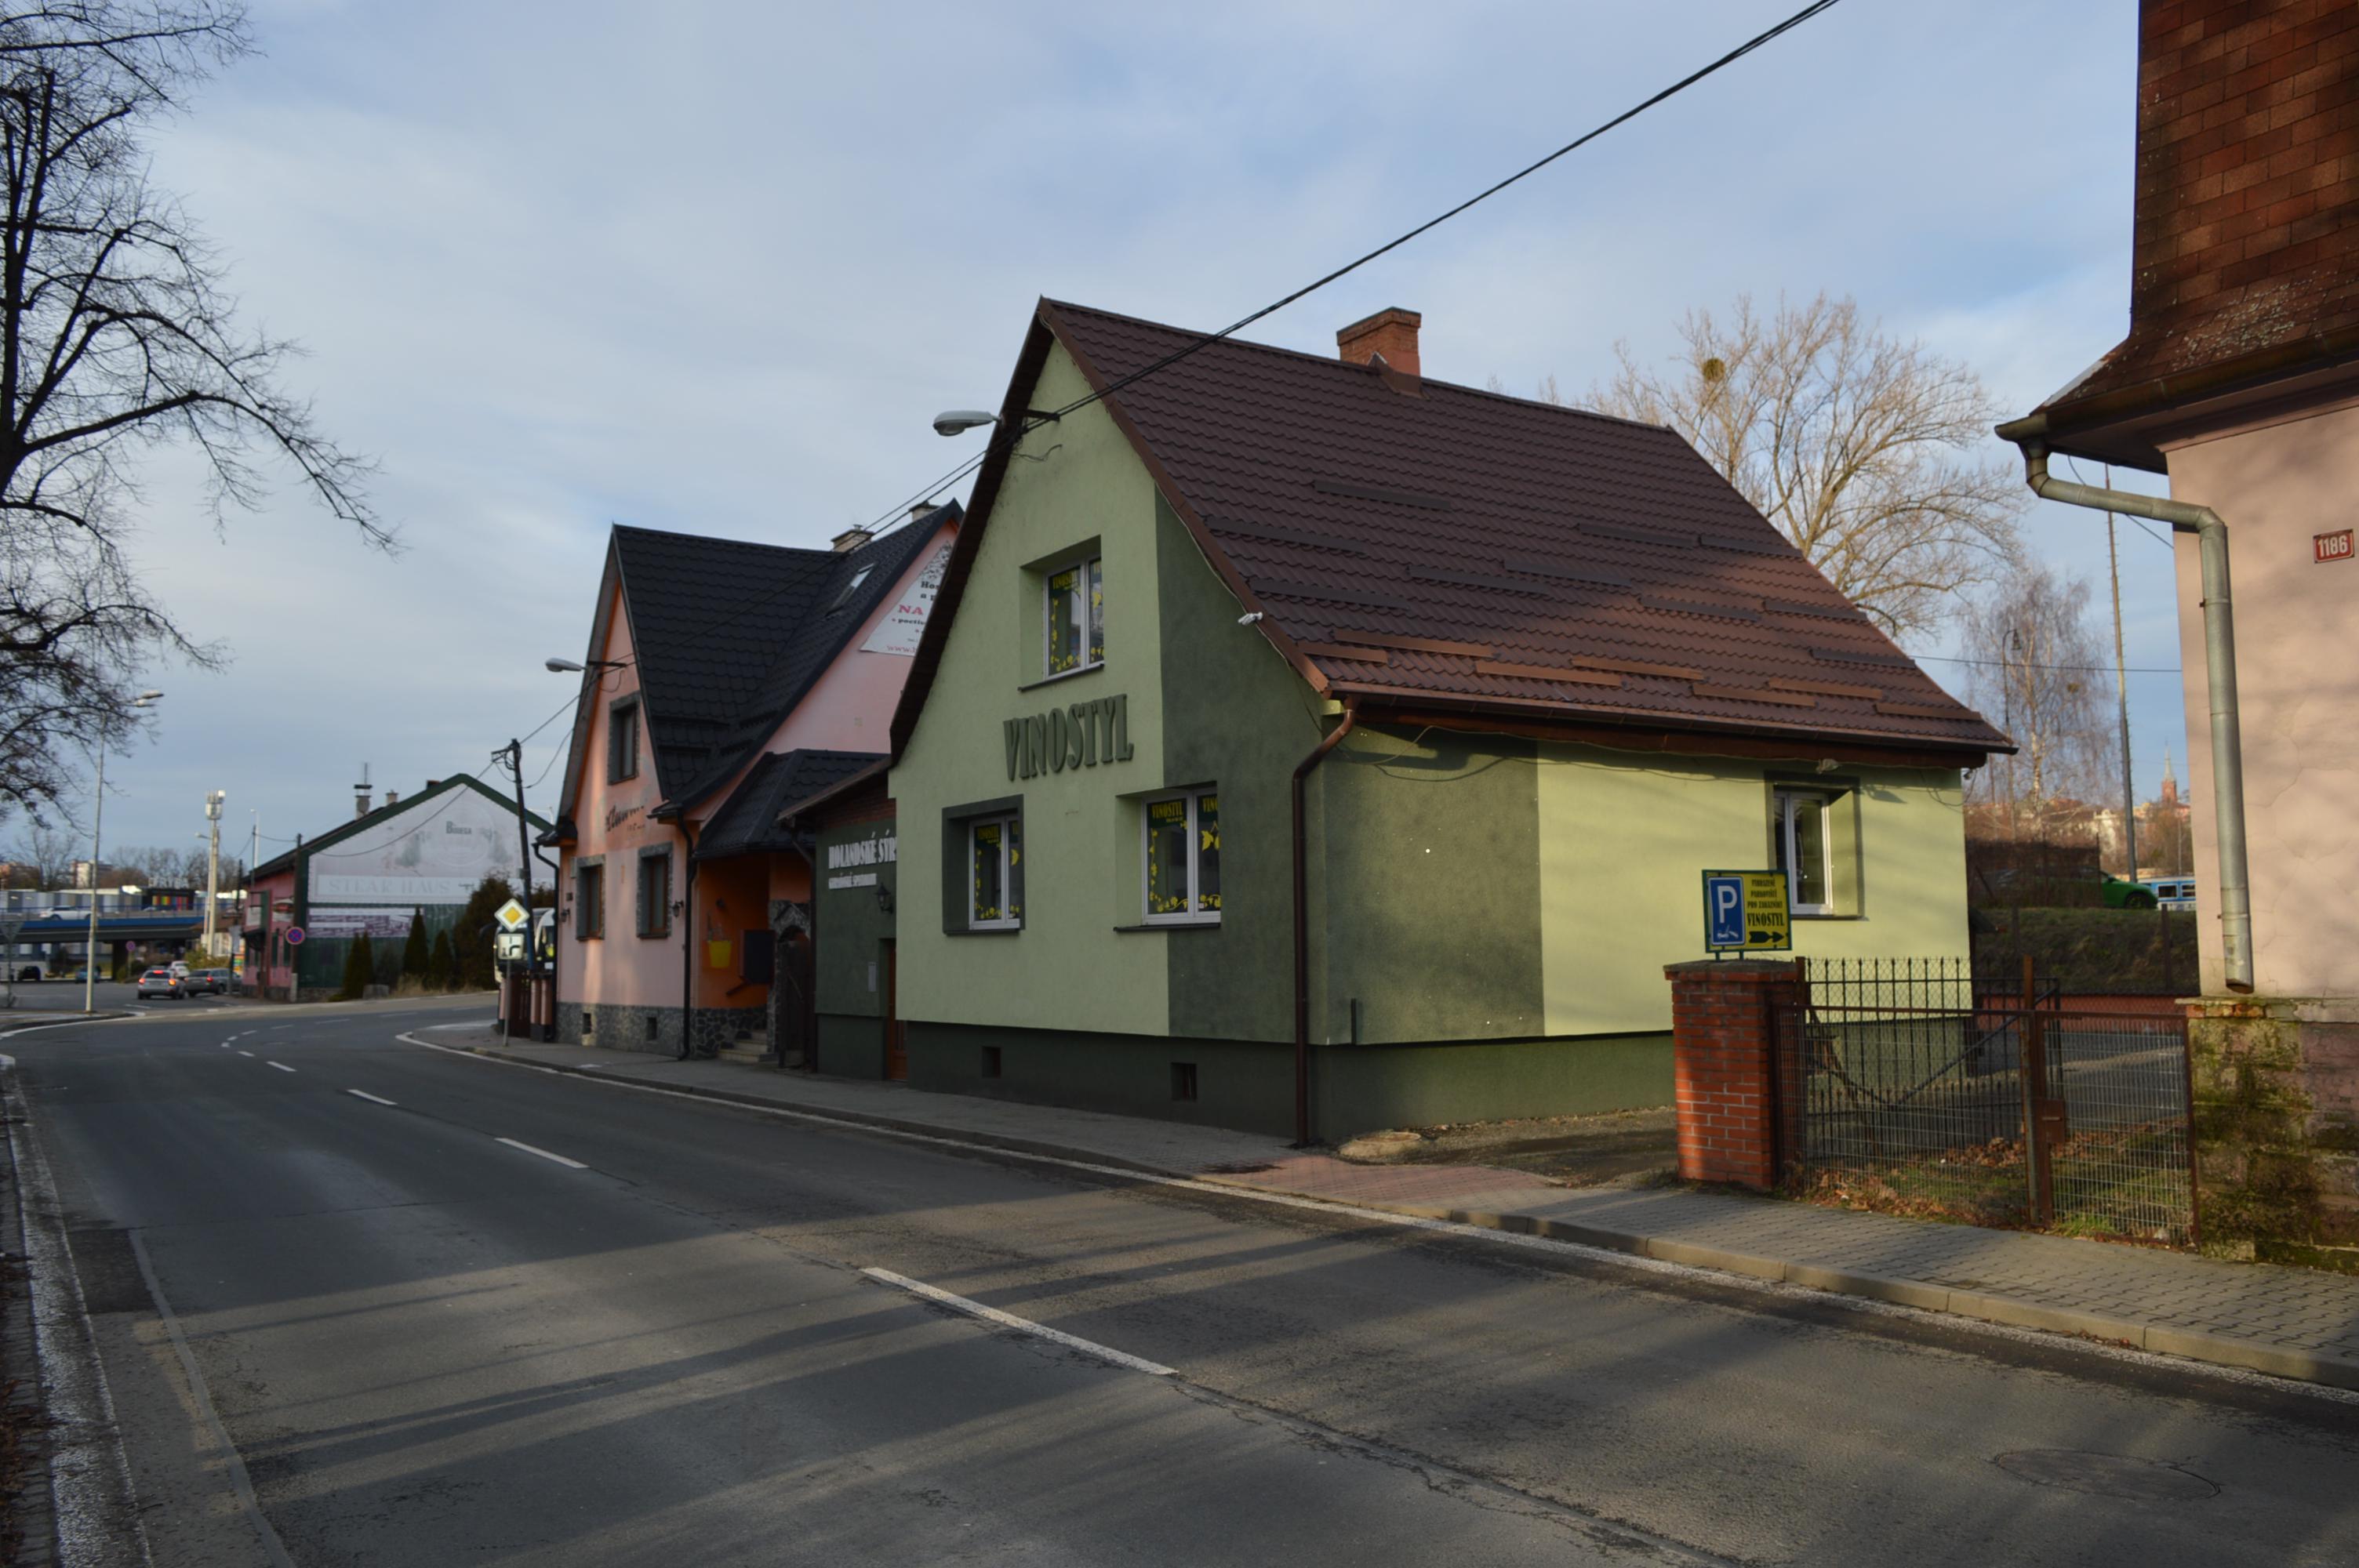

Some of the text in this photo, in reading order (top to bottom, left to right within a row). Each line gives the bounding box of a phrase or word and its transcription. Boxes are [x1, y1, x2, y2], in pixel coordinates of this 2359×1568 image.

[2317, 535, 2348, 557] 1186
[921, 581, 940, 590] Hos
[899, 604, 924, 615] NA
[1002, 694, 1134, 782] VINOSTYL
[878, 829, 897, 863] SÝR
[1717, 885, 1737, 924] P
[1747, 913, 1784, 927] VINOSTYL
